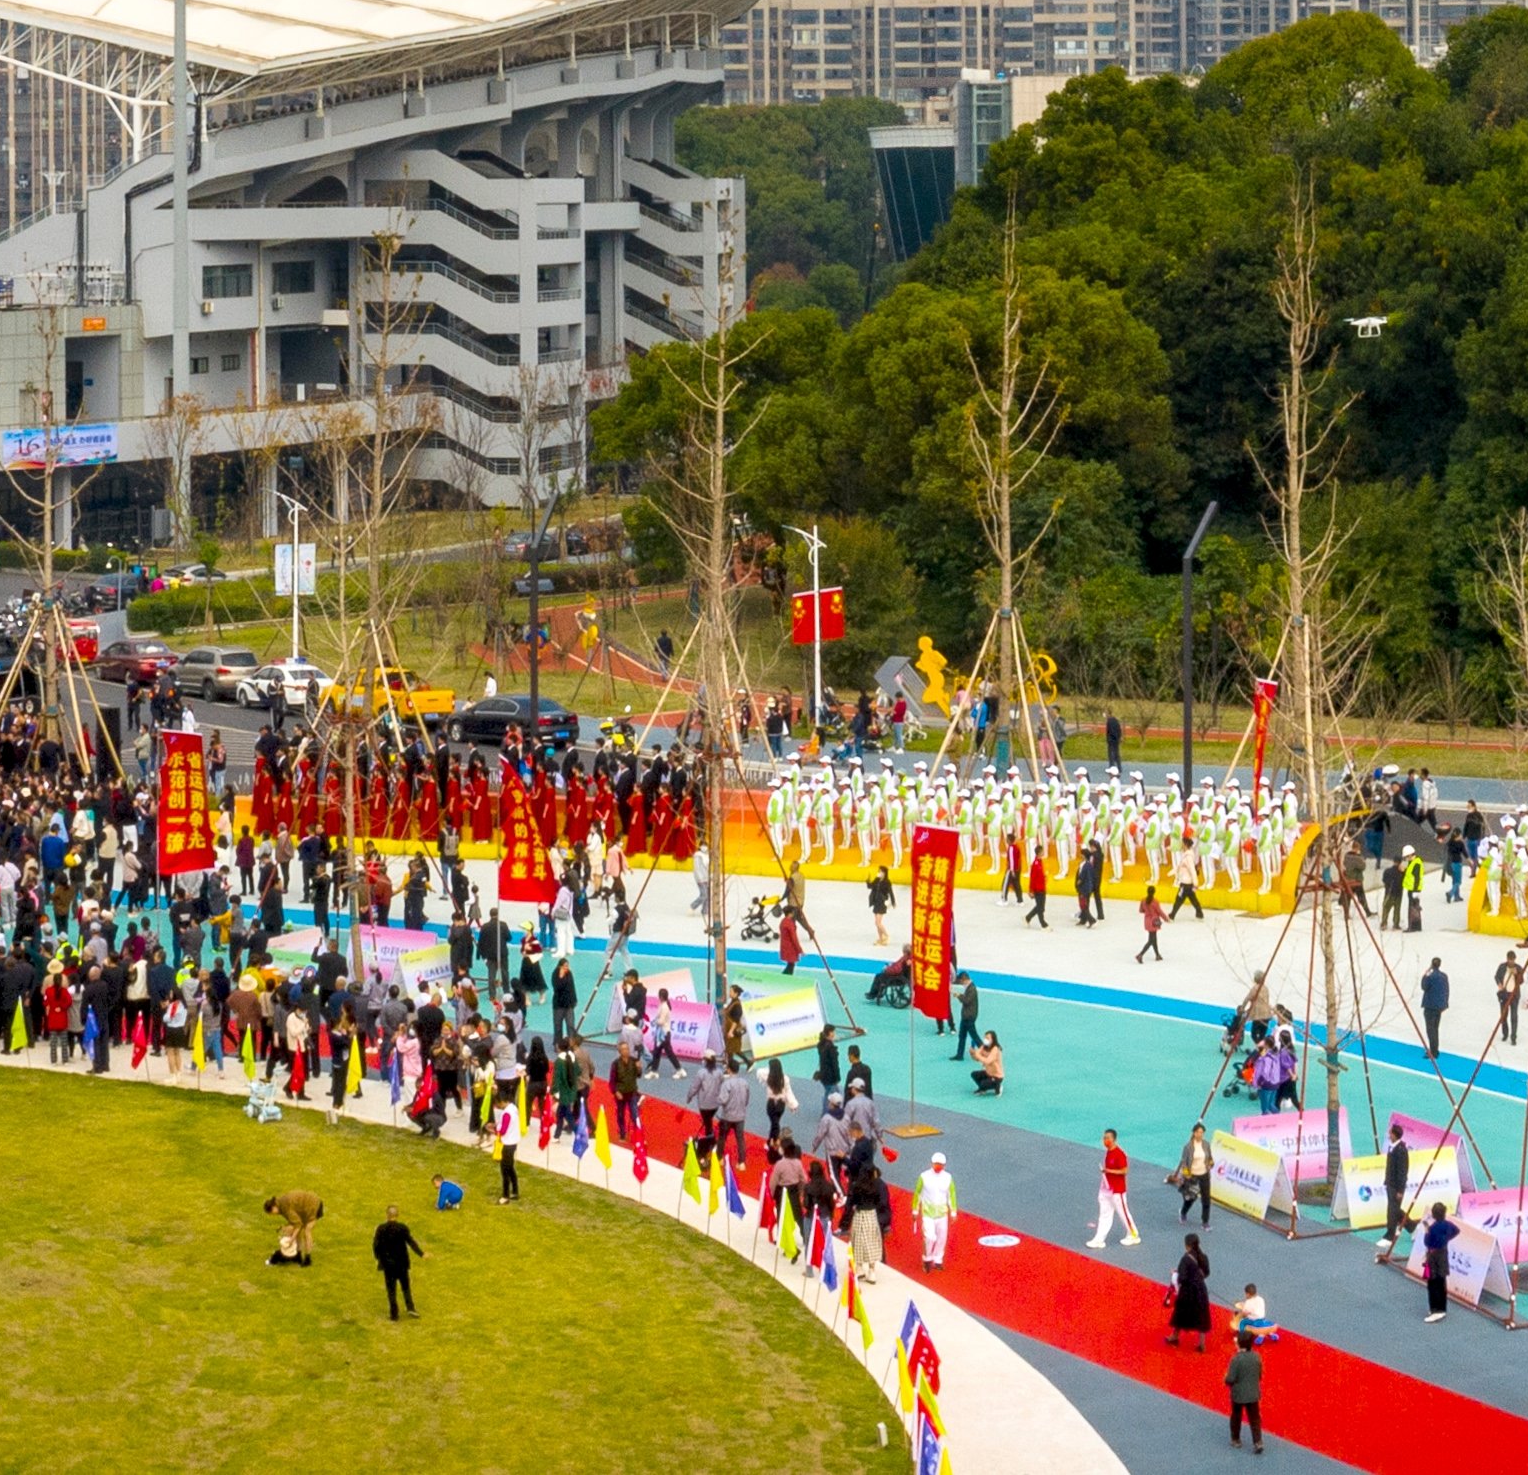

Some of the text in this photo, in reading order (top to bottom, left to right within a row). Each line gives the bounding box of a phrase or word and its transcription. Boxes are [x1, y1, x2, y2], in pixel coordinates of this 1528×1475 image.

[913, 853, 934, 987] 奋进新江西
[923, 856, 950, 992] 精彩省运会
[650, 1019, 700, 1035] 江银行
